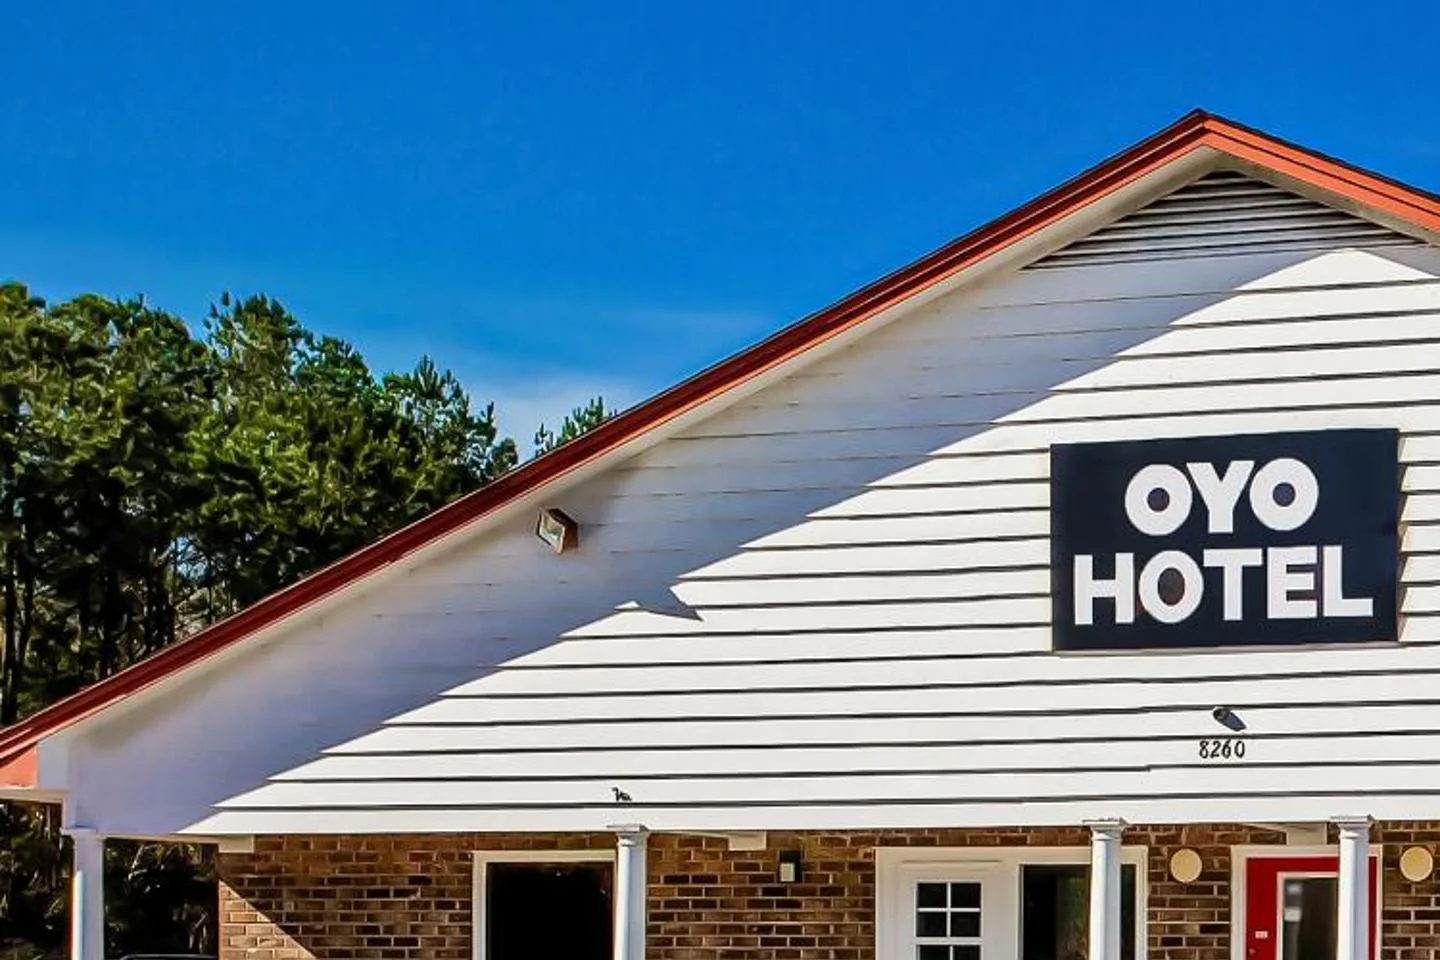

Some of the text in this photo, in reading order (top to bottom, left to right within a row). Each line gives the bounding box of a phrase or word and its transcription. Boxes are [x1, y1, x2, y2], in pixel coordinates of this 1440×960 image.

[1124, 457, 1319, 536] OYO
[1073, 545, 1374, 626] HOTEL
[1199, 739, 1246, 759] 8260
